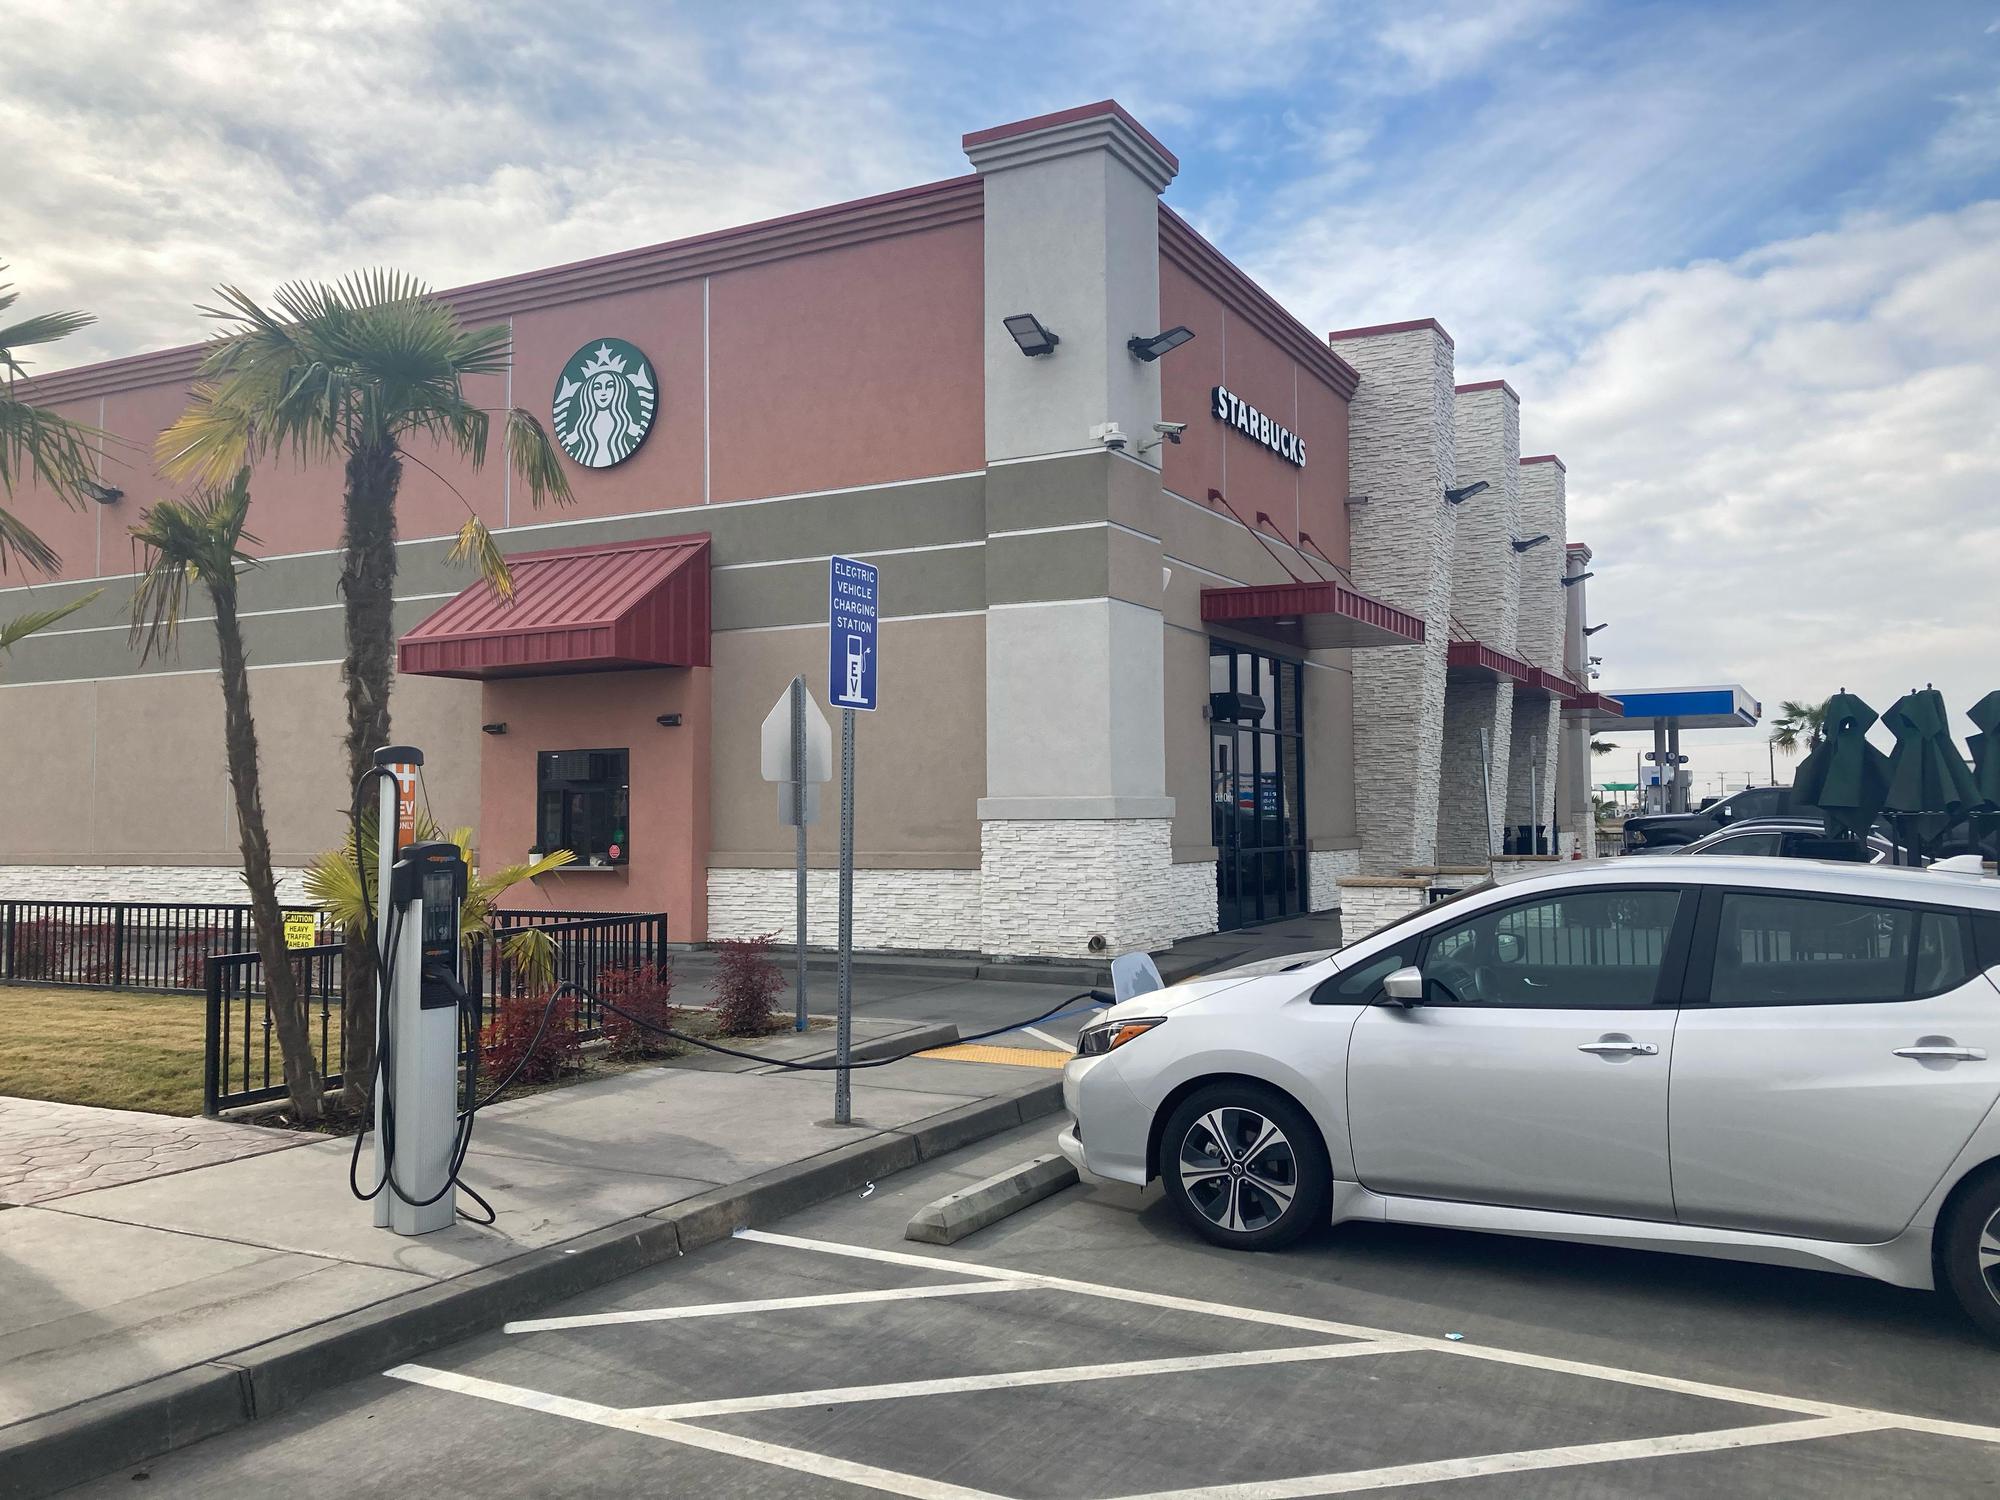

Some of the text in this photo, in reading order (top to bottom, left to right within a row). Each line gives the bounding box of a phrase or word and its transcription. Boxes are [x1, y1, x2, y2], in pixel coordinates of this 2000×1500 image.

[1214, 385, 1306, 468] STARBUCKS
[834, 562, 875, 583] ELECTRIC
[837, 580, 872, 600] VEHICLE
[833, 598, 875, 617] CHARGING
[837, 616, 872, 634] STATION
[400, 800, 413, 815] EV
[286, 914, 314, 923] CAUTION
[287, 933, 312, 941] TRAFFIC
[289, 925, 309, 933] HEAVY
